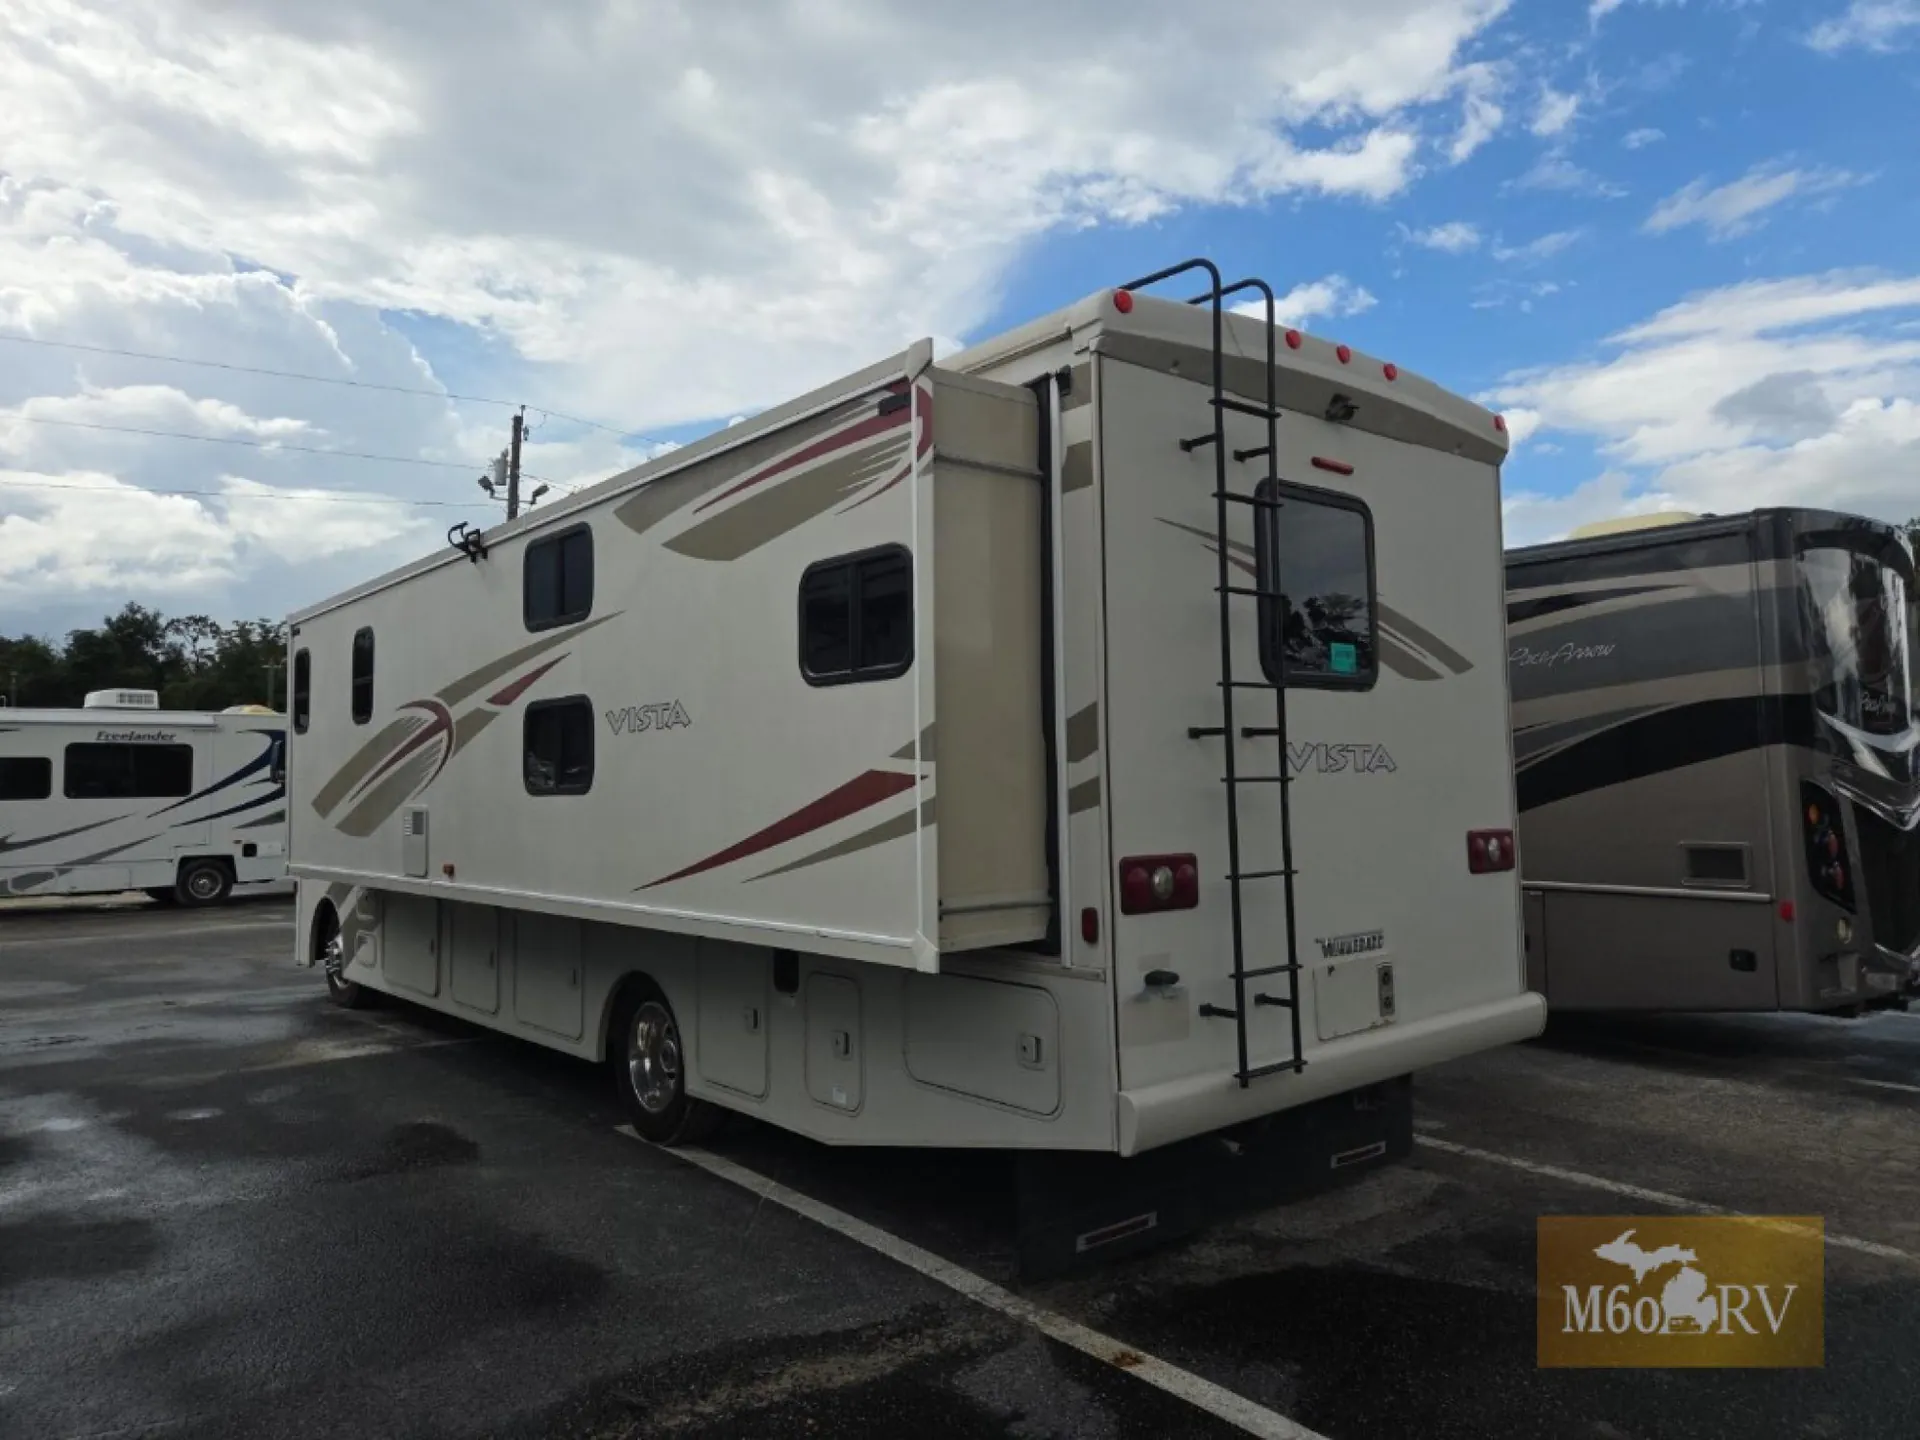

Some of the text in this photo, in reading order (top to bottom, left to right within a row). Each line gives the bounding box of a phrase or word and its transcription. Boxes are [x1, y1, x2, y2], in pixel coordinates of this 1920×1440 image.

[605, 699, 692, 736] VISTA
[96, 730, 177, 742] Freelander
[1285, 741, 1398, 773] VISTA
